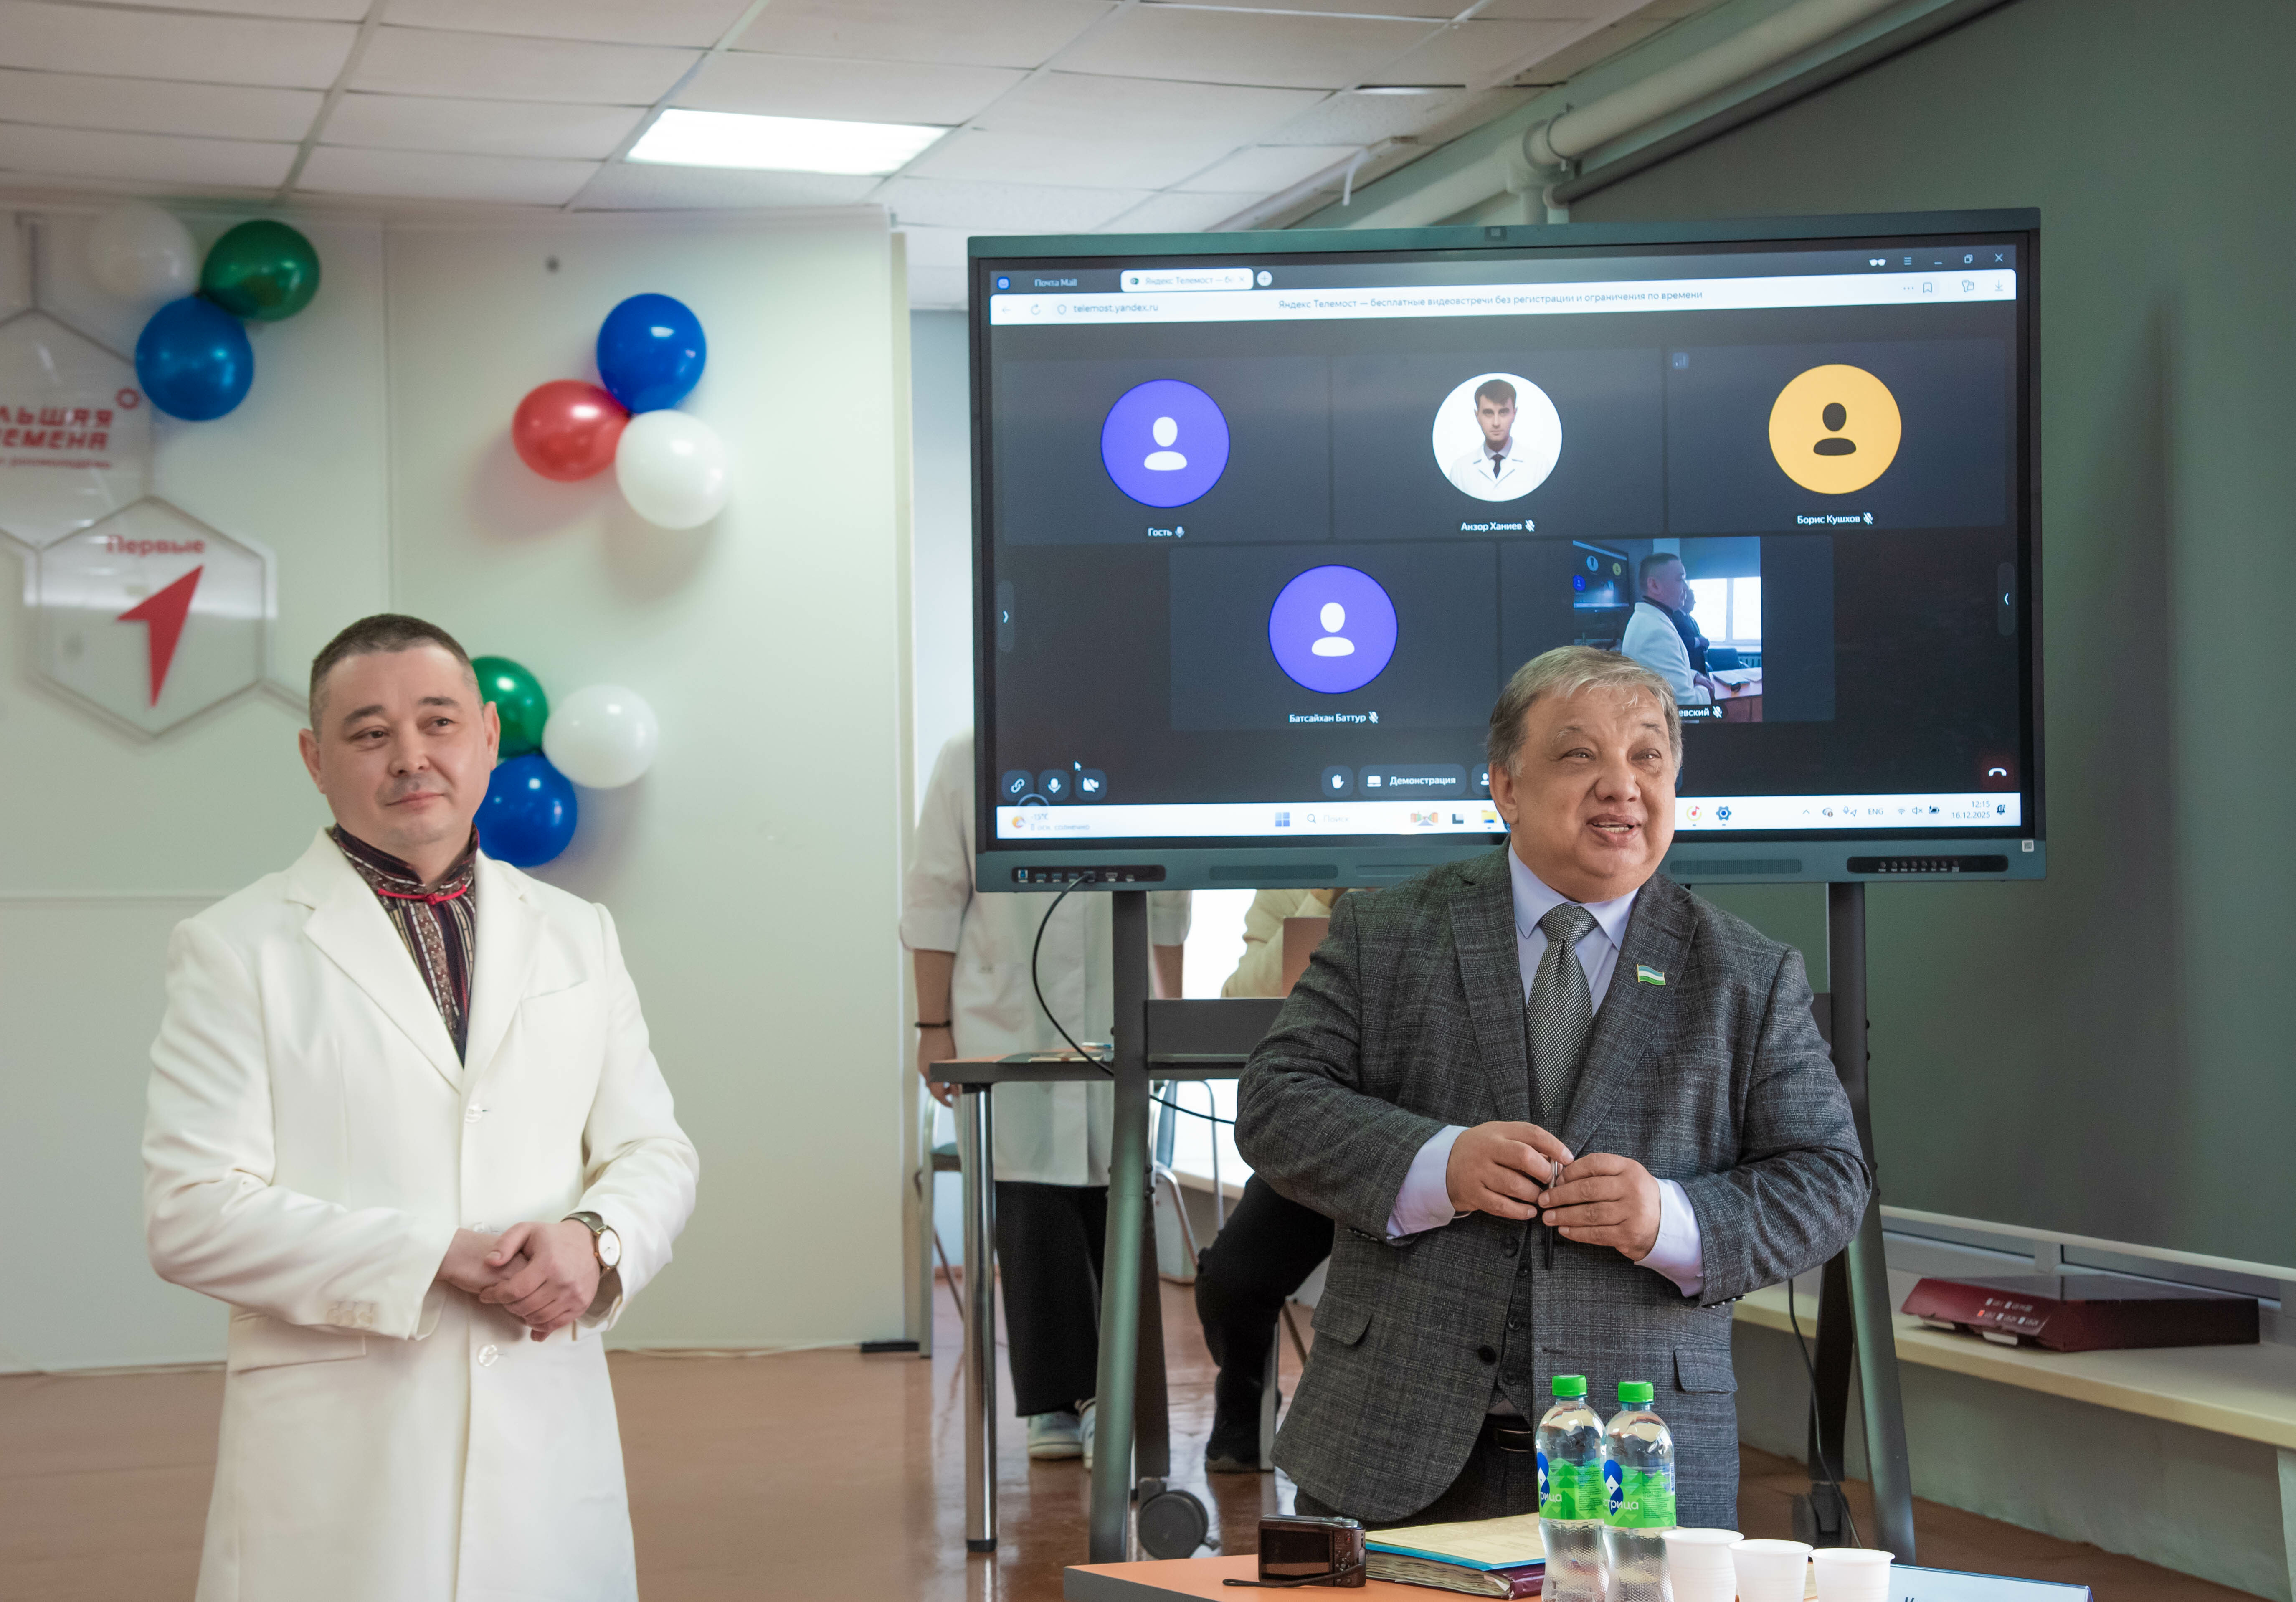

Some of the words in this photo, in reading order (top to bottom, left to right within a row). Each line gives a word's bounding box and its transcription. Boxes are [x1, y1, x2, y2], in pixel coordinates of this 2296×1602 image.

[1034, 279, 1059, 287] Почта
[1279, 300, 1311, 309] Яндекс
[1314, 299, 1357, 308] Телемост
[1371, 298, 1425, 307] бесплатные
[1428, 297, 1493, 307] видеовстречи
[1495, 295, 1511, 304] без
[1514, 295, 1574, 305] регистрации
[1585, 293, 1645, 303] ограничения
[1662, 291, 1703, 301] времени
[1073, 304, 1158, 314] telemost.yandex.ru
[0, 428, 108, 451] ЕМЕНА
[1797, 515, 1825, 525] Борис
[1826, 515, 1860, 525] Кушхов
[1148, 527, 1173, 537] Гость
[1461, 522, 1489, 532] Анзор
[1490, 522, 1522, 530] Ханиев
[106, 534, 205, 558] Первые
[1289, 713, 1334, 723] Батсайхан
[1336, 713, 1366, 723] Баттур
[1389, 776, 1456, 786] Демонстрация
